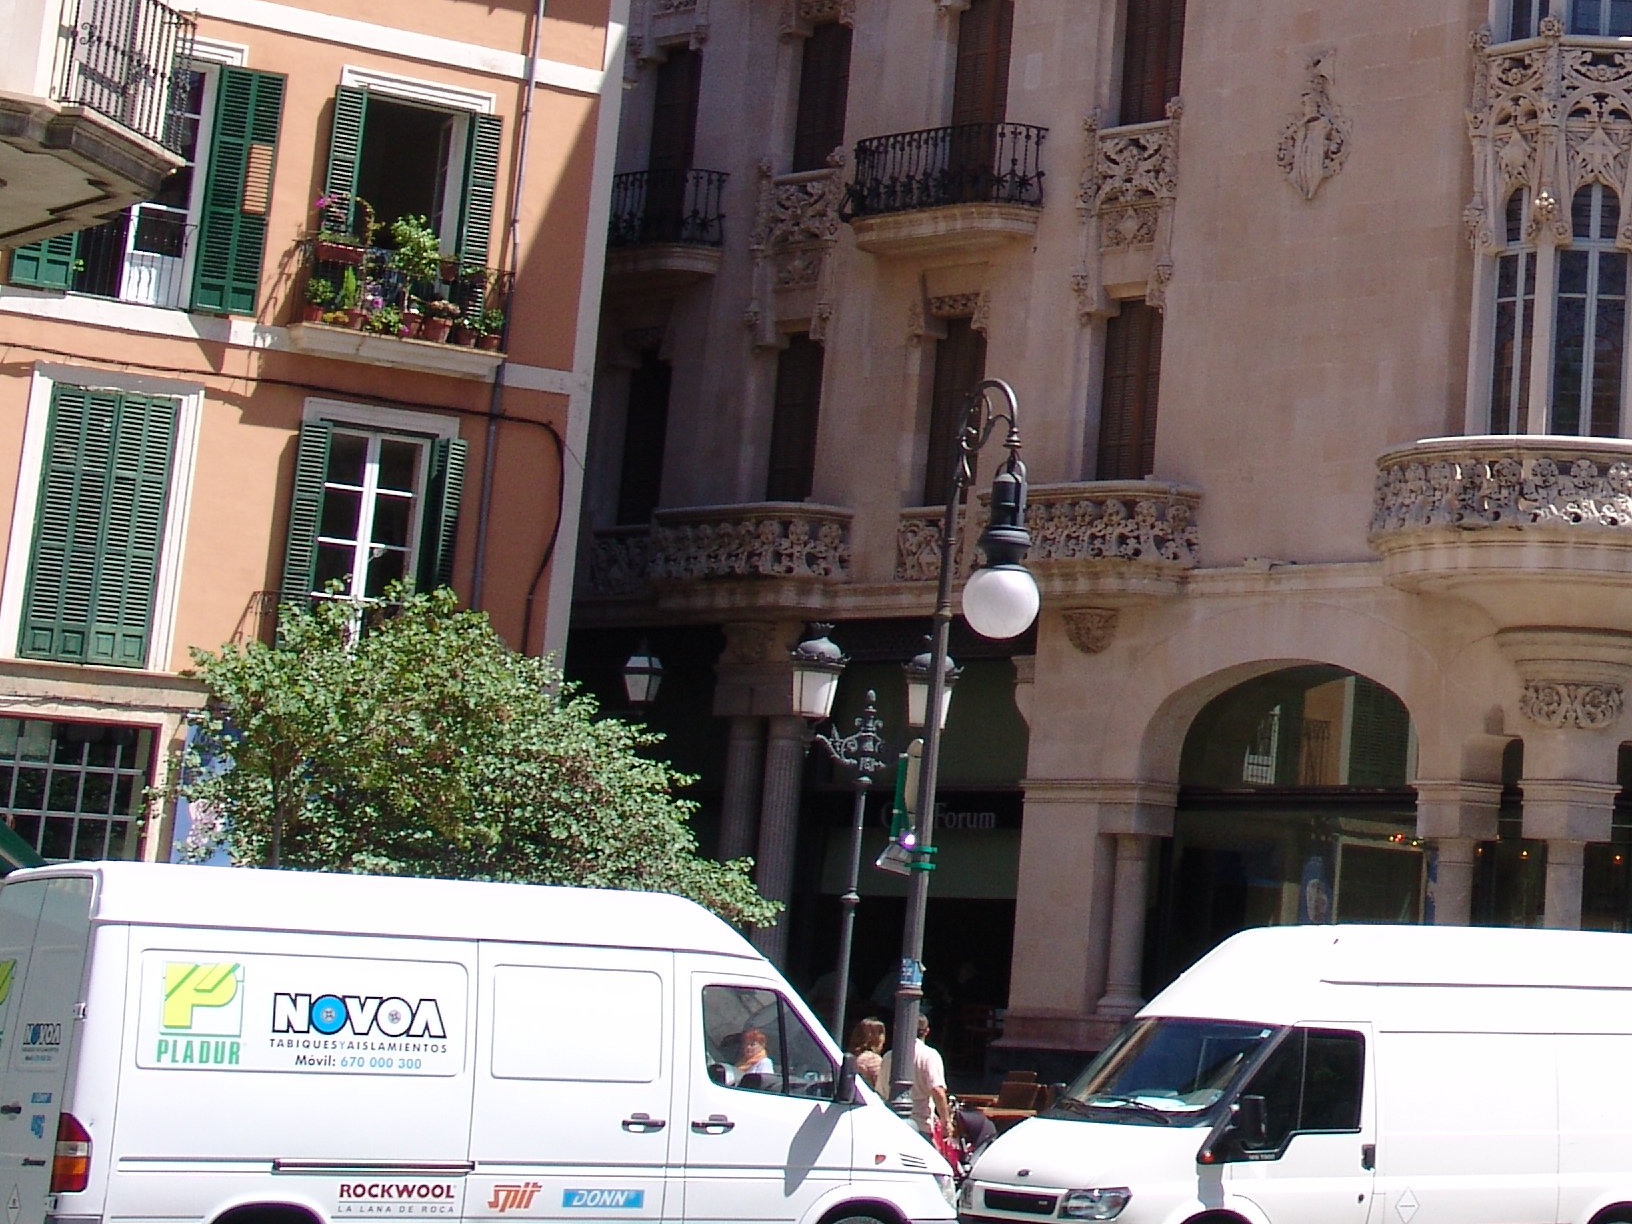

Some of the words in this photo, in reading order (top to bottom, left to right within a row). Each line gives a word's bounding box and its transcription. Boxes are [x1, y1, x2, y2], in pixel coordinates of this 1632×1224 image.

[934, 802, 996, 829] Forum
[271, 992, 447, 1040] NOVOA
[156, 1039, 241, 1065] PLADUR
[295, 1054, 336, 1067] Móvil:
[340, 1056, 365, 1068] 670
[369, 1057, 394, 1069] 000
[398, 1058, 422, 1069] 300
[339, 1183, 455, 1199] ROCKWOOL
[572, 1189, 629, 1206] DONN
[337, 1205, 352, 1213] LA
[360, 1205, 392, 1213] LANA
[399, 1205, 414, 1213] DE
[421, 1206, 455, 1214] ROCA
